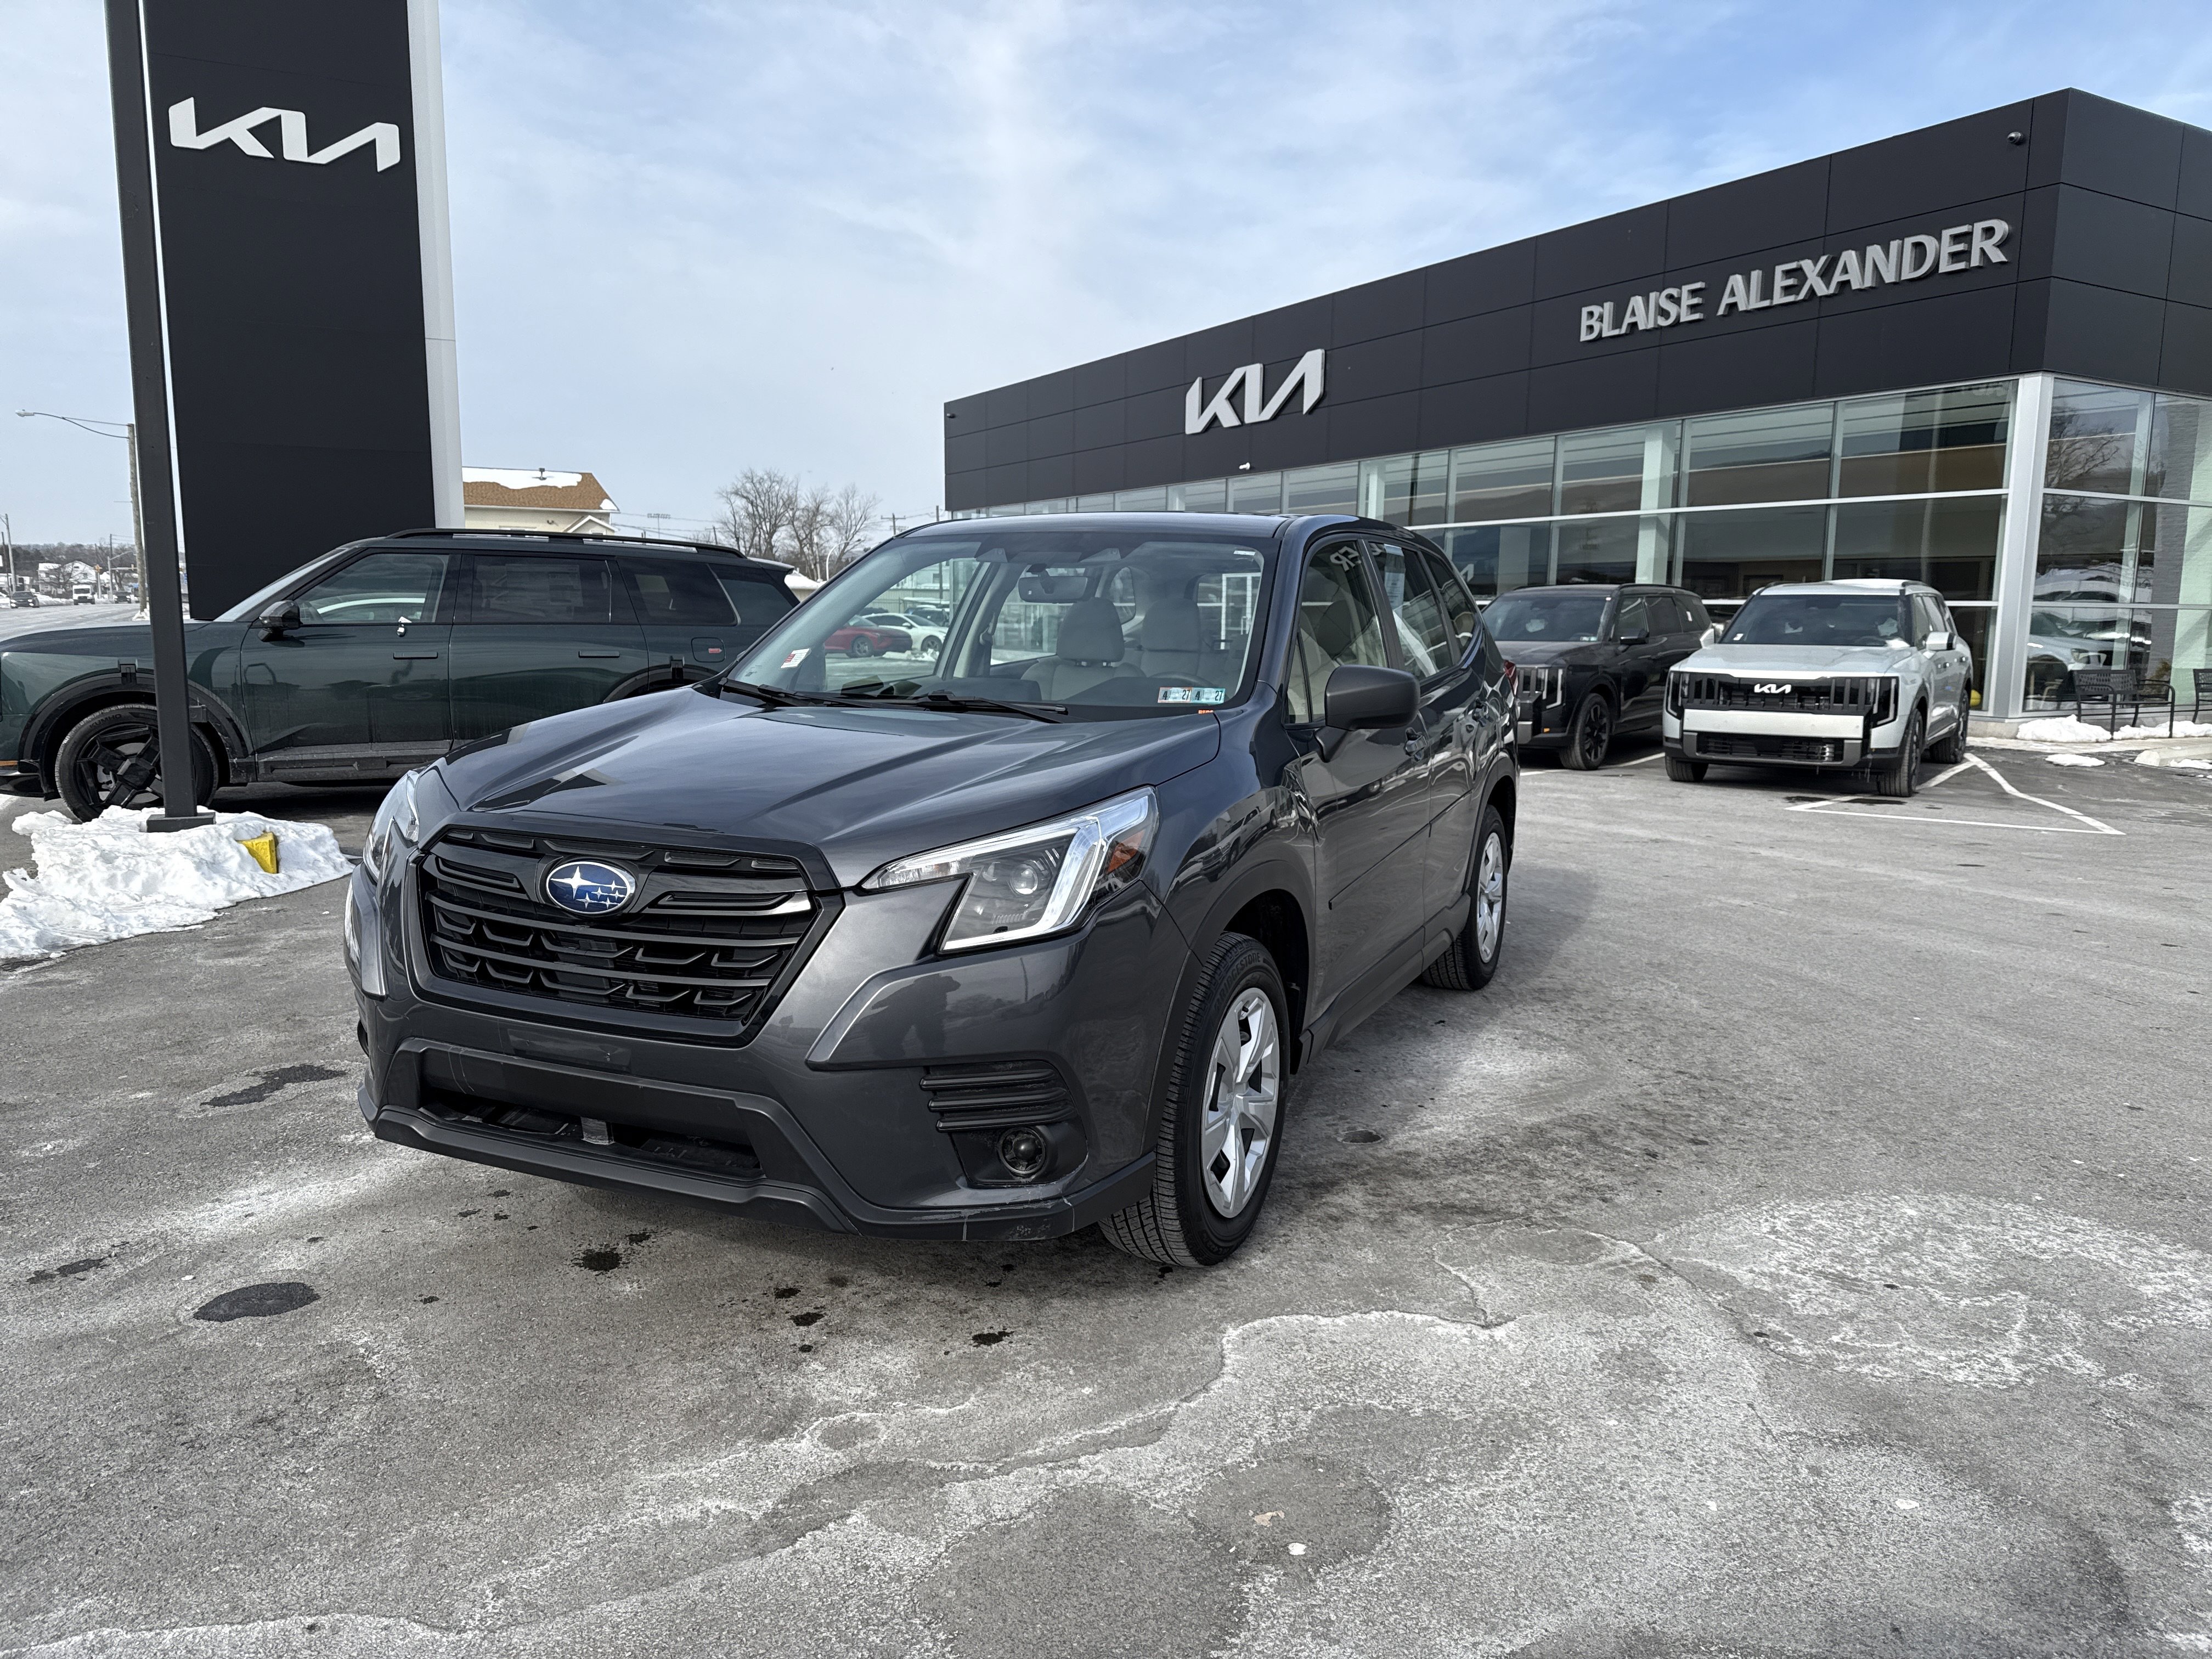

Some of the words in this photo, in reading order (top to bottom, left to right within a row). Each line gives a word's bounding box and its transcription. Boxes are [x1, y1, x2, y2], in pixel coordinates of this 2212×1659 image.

[168, 97, 400, 172] KIA
[1579, 281, 1706, 342] BLAISE
[1716, 219, 2010, 317] ALEXANDER
[1185, 348, 1325, 435] KIA
[1162, 691, 1168, 701] 4
[1182, 689, 1190, 701] 27
[1195, 691, 1201, 701] 4
[1215, 690, 1223, 702] 27
[1754, 683, 1792, 695] KIA
[89, 713, 122, 729] KUMHO
[1214, 952, 1261, 1011] BRIDGESTONE
